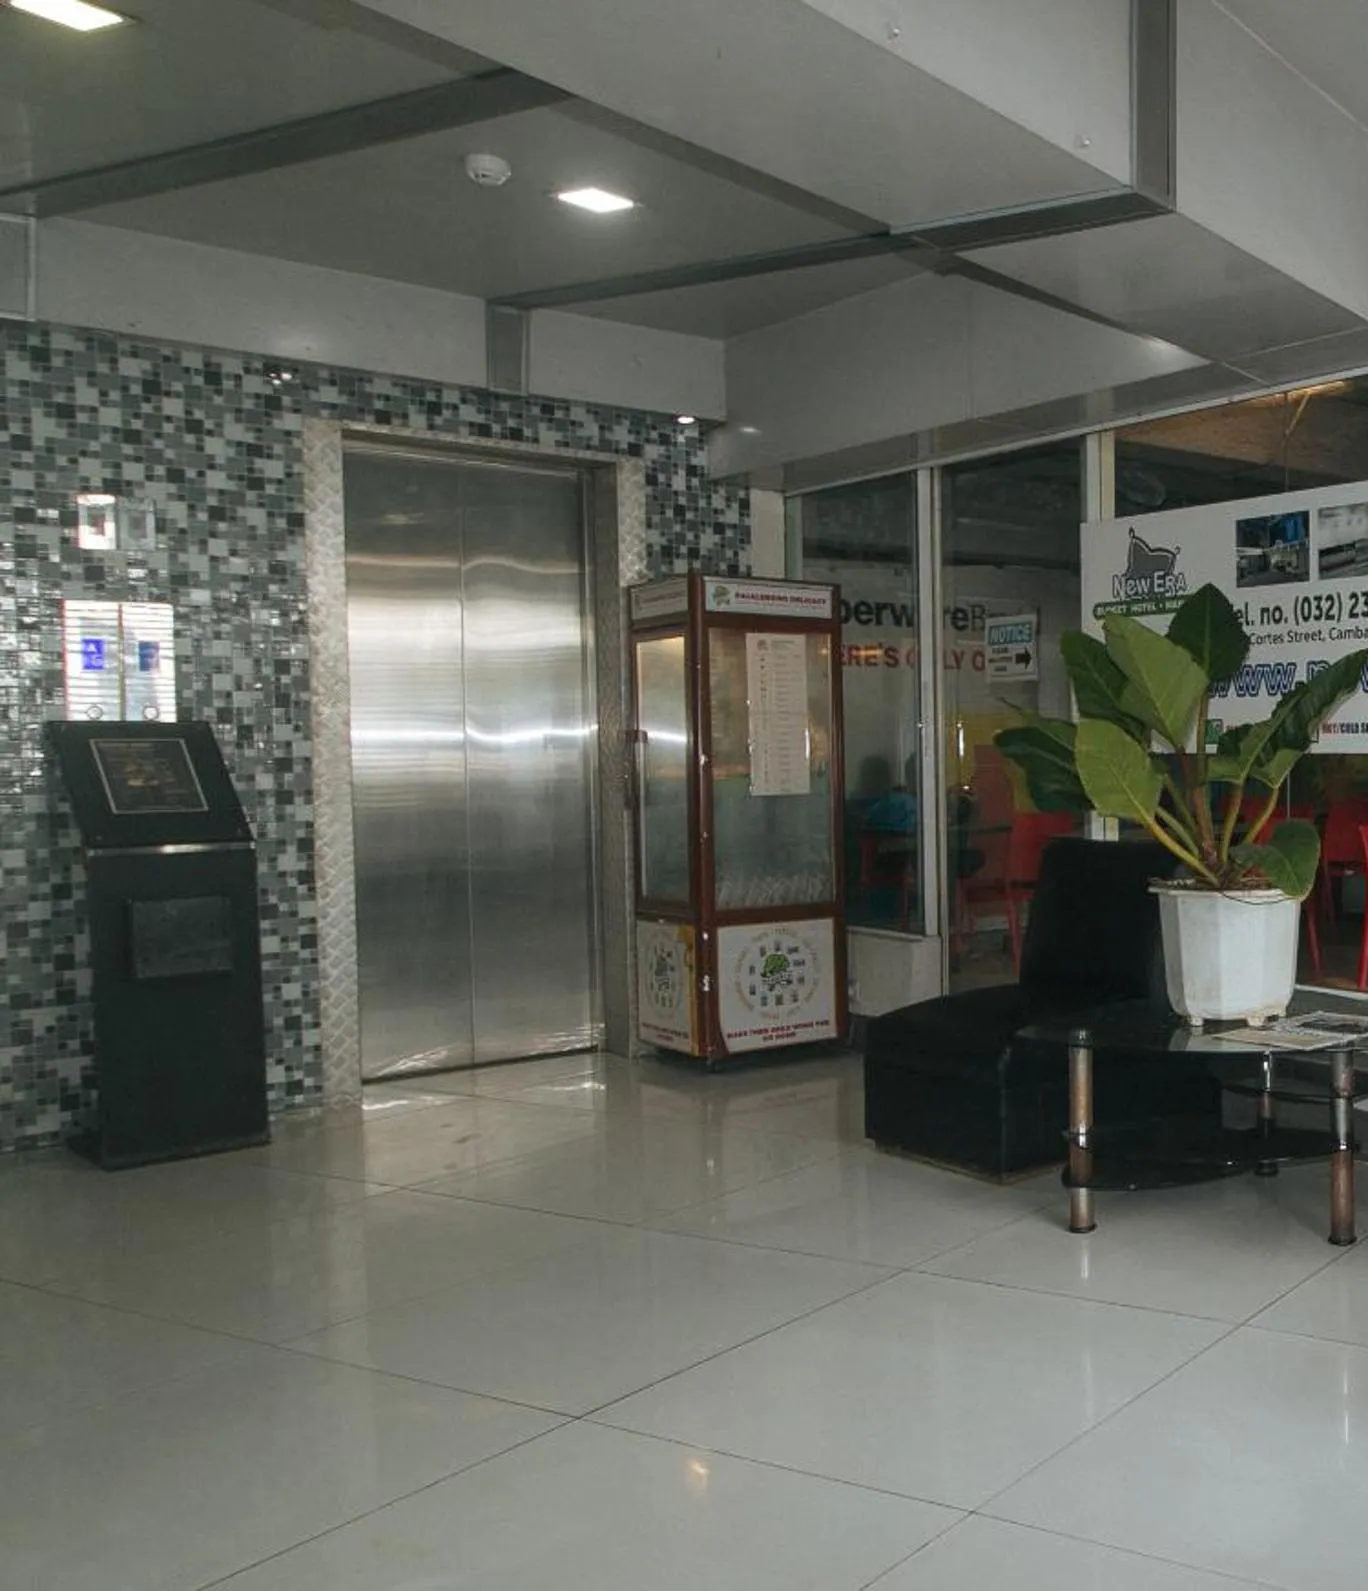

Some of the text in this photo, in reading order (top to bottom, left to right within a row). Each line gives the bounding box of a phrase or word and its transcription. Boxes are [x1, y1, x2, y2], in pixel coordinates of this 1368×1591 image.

[1112, 573, 1150, 599] New
[1235, 602, 1255, 627] el.
[1260, 605, 1288, 626] no.
[1294, 592, 1343, 627] (032)
[991, 624, 1031, 643] NOTICE
